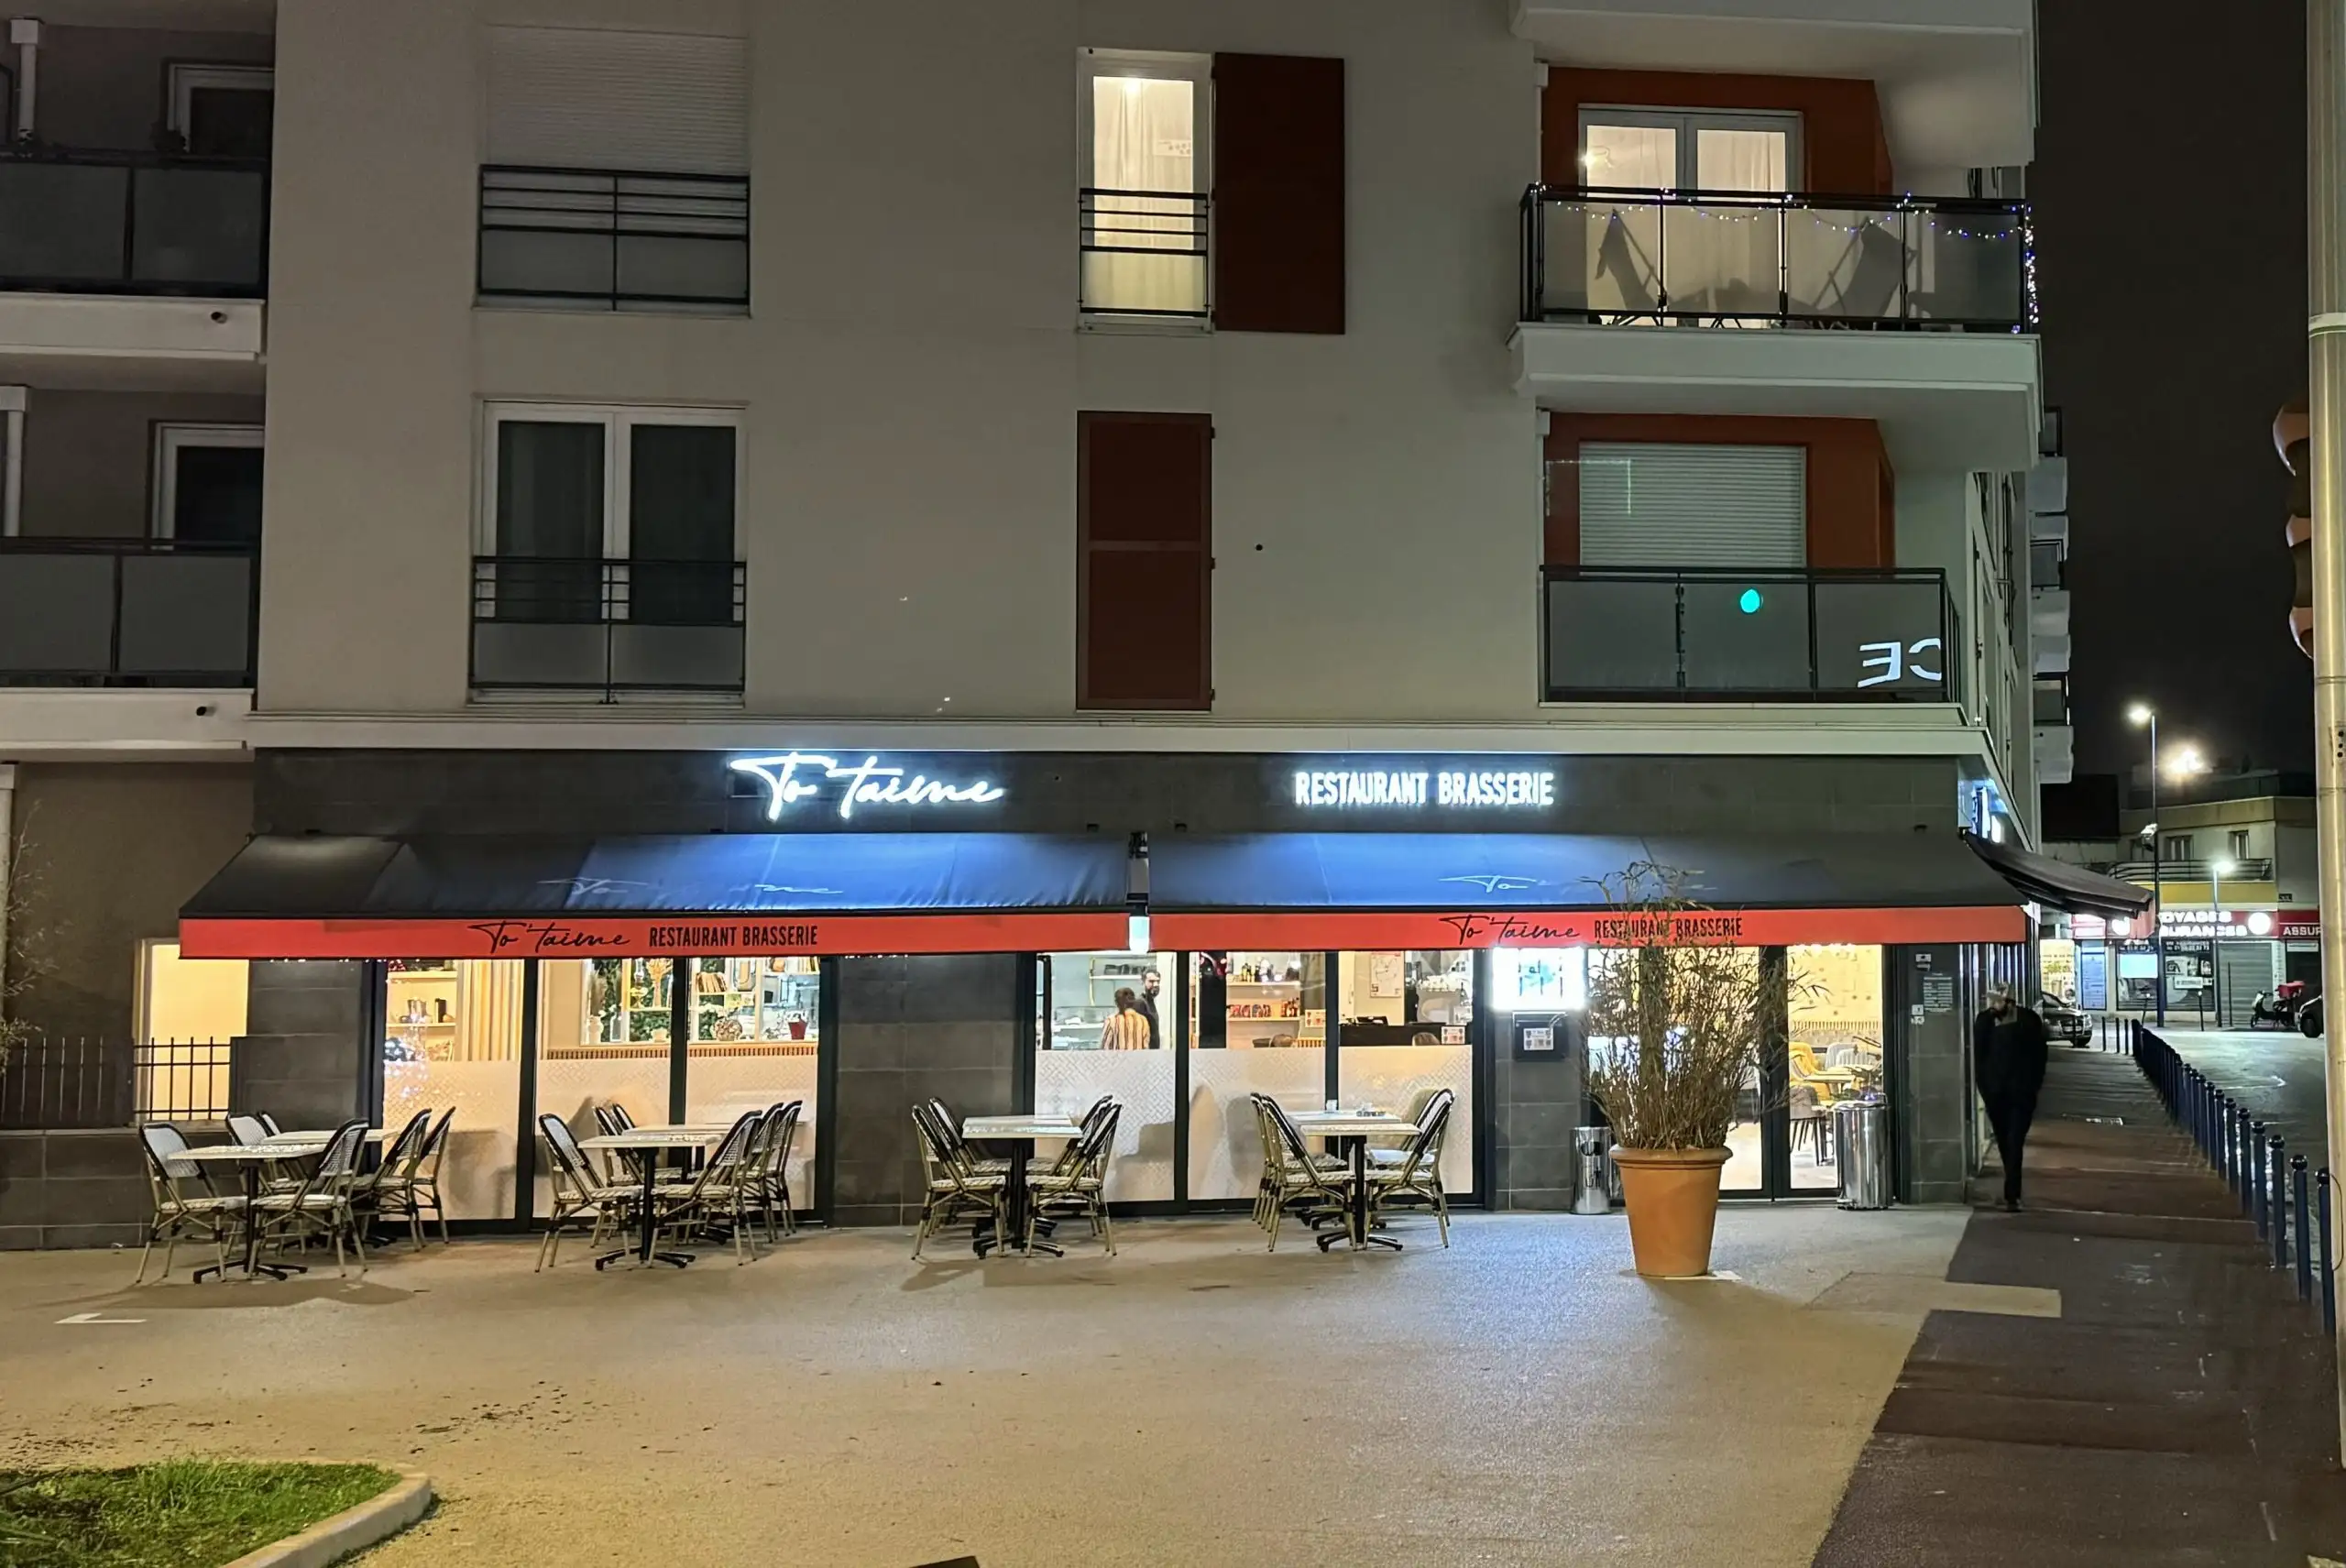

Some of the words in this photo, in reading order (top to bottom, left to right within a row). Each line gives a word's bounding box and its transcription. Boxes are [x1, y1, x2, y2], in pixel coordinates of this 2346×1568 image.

[1295, 772, 1429, 805] RESTAURANT
[1438, 772, 1555, 805] BRASSERIE
[649, 927, 737, 947] RESTAURANT
[742, 926, 818, 946] BRASSERIE
[1676, 917, 1743, 938] BRASSERIE
